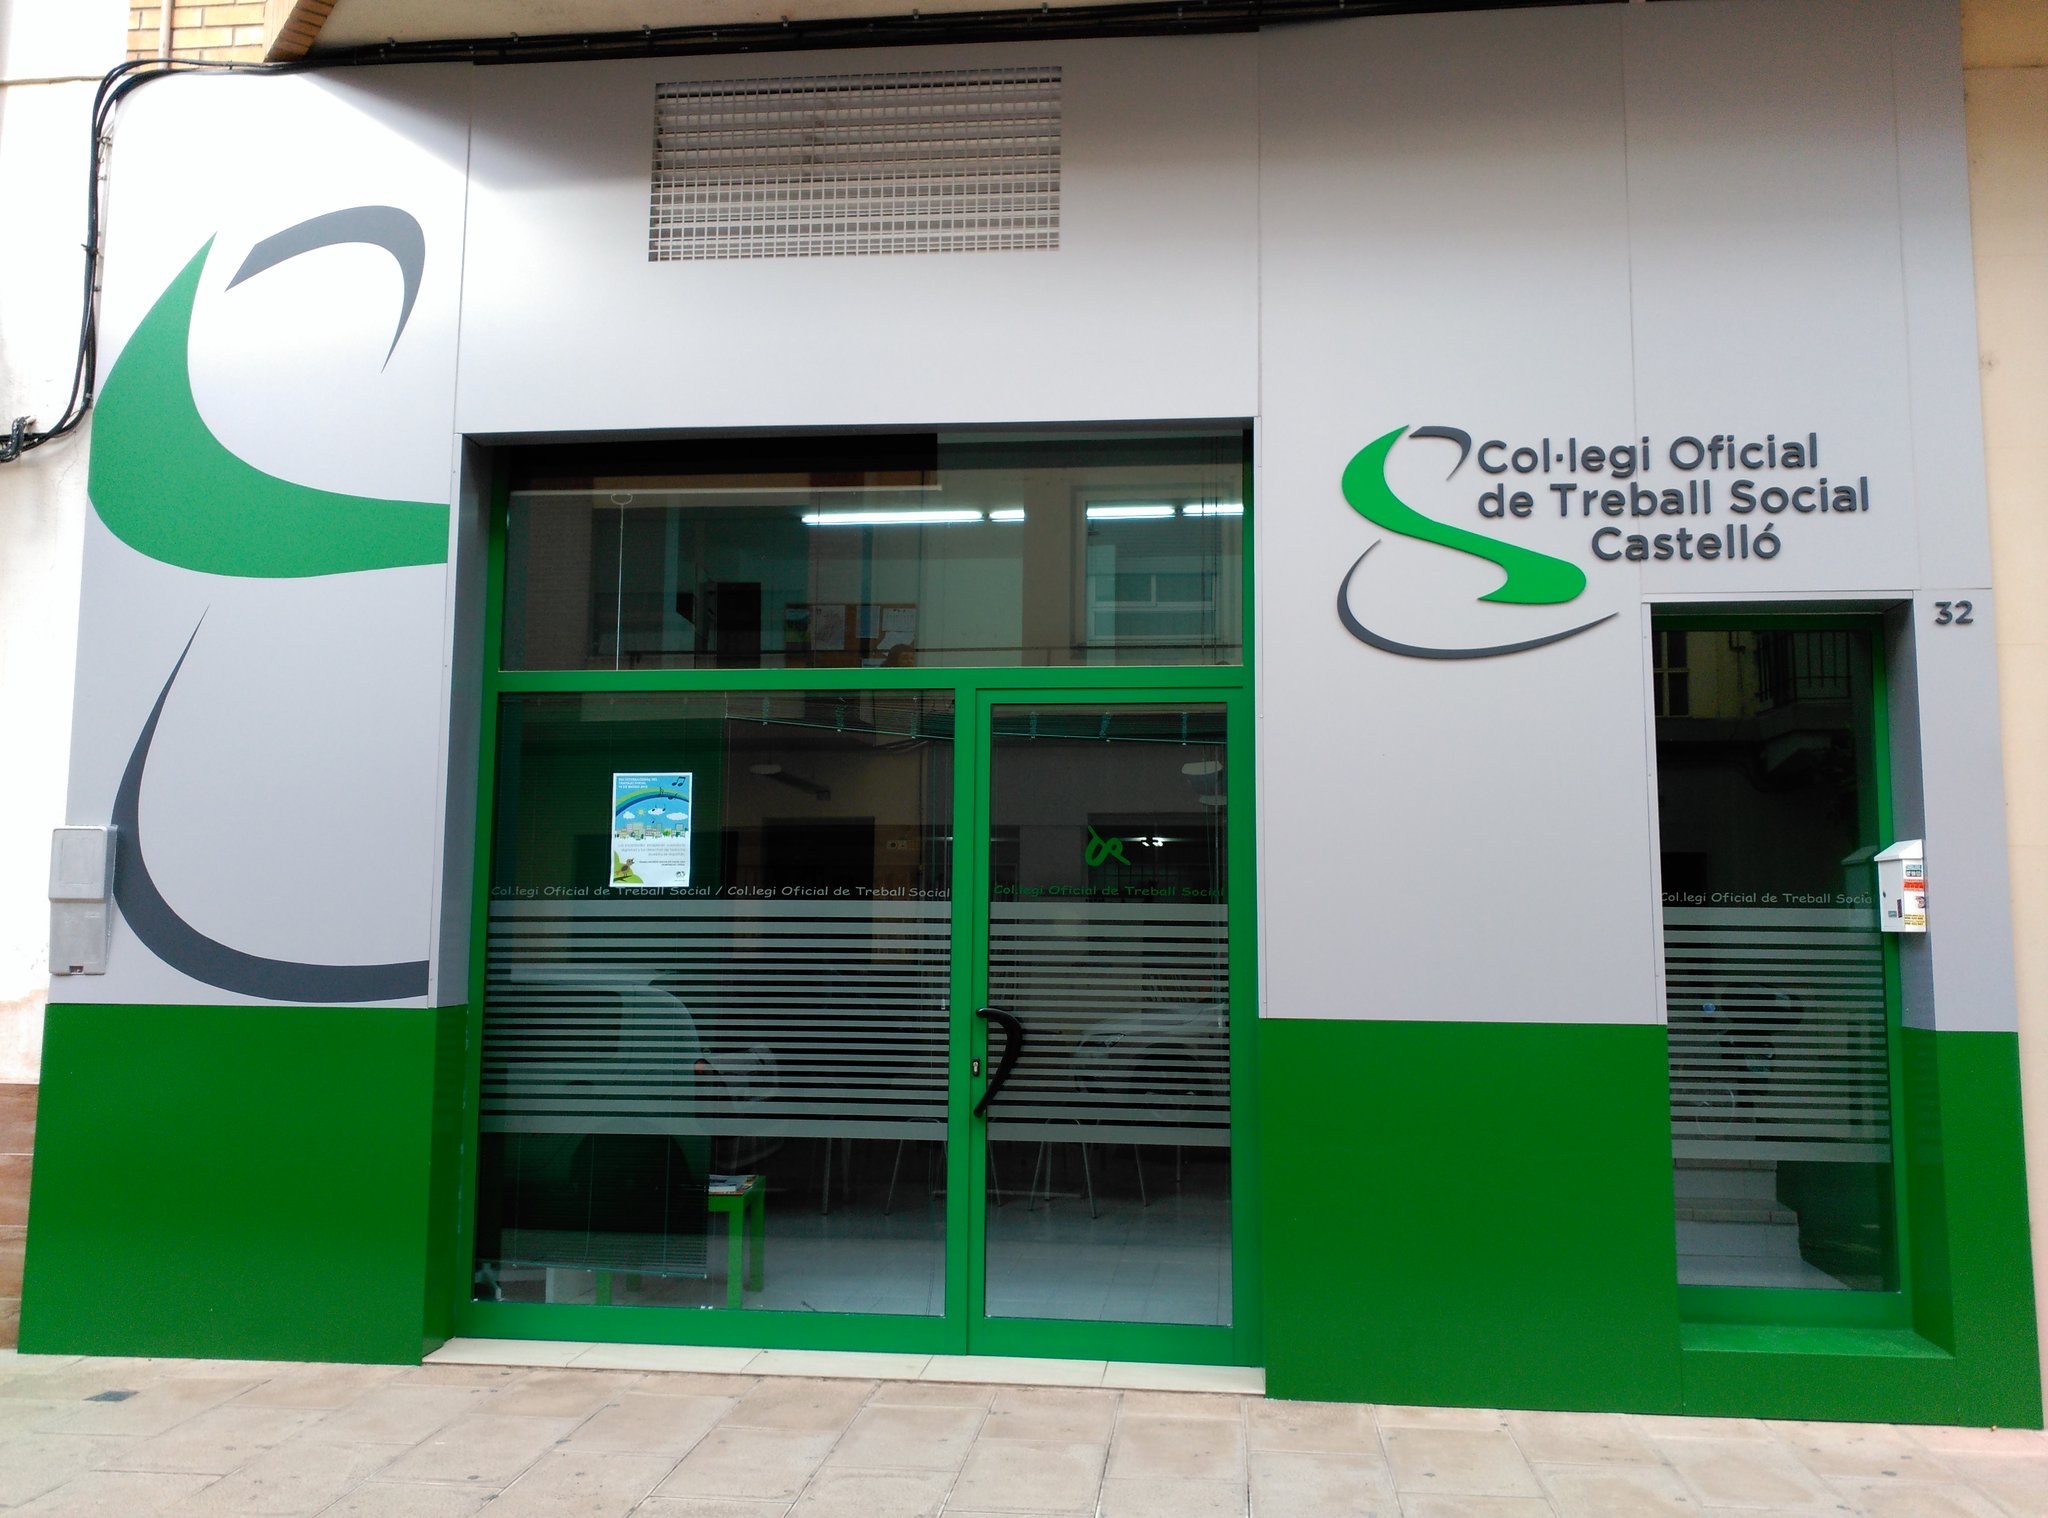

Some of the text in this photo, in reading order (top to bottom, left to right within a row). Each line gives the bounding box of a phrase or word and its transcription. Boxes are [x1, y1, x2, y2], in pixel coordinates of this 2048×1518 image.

[1477, 432, 1818, 478] Col·legi Oficial
[1478, 476, 1869, 518] de Treball Social
[1591, 522, 1781, 561] Castelló
[1934, 600, 1975, 625] 32
[491, 886, 539, 898] Col.legi
[543, 886, 589, 896] Oficial
[593, 886, 611, 896] de
[616, 886, 664, 896] Treball
[669, 886, 711, 896] Social
[727, 886, 776, 898] Col.legi
[781, 886, 828, 896] Oficial
[833, 886, 850, 896] de
[856, 886, 905, 897] Treball
[909, 887, 950, 898] Social
[1049, 884, 1097, 896] Oficial
[1101, 885, 1119, 896] de
[1125, 886, 1176, 897] Treball
[1181, 887, 1225, 898] Social
[1711, 892, 1757, 903] Oficial
[1761, 892, 1779, 903] de
[1782, 893, 1831, 904] Treball
